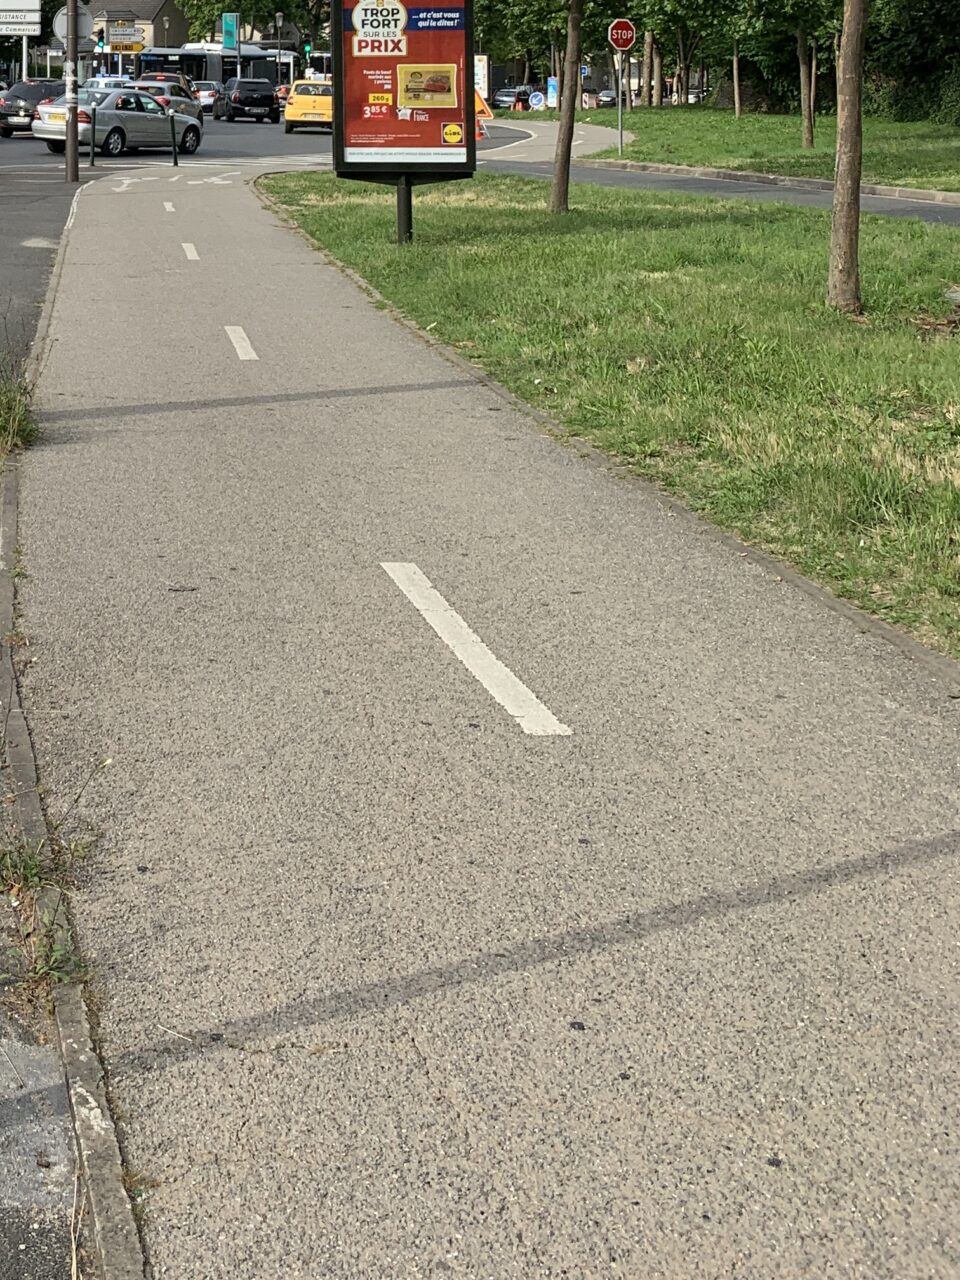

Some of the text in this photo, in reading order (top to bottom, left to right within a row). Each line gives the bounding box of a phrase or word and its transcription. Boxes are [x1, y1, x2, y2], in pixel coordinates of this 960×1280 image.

[362, 8, 400, 18] TROP
[361, 19, 401, 29] FORT
[612, 29, 633, 39] STOP
[357, 40, 403, 52] PRIX
